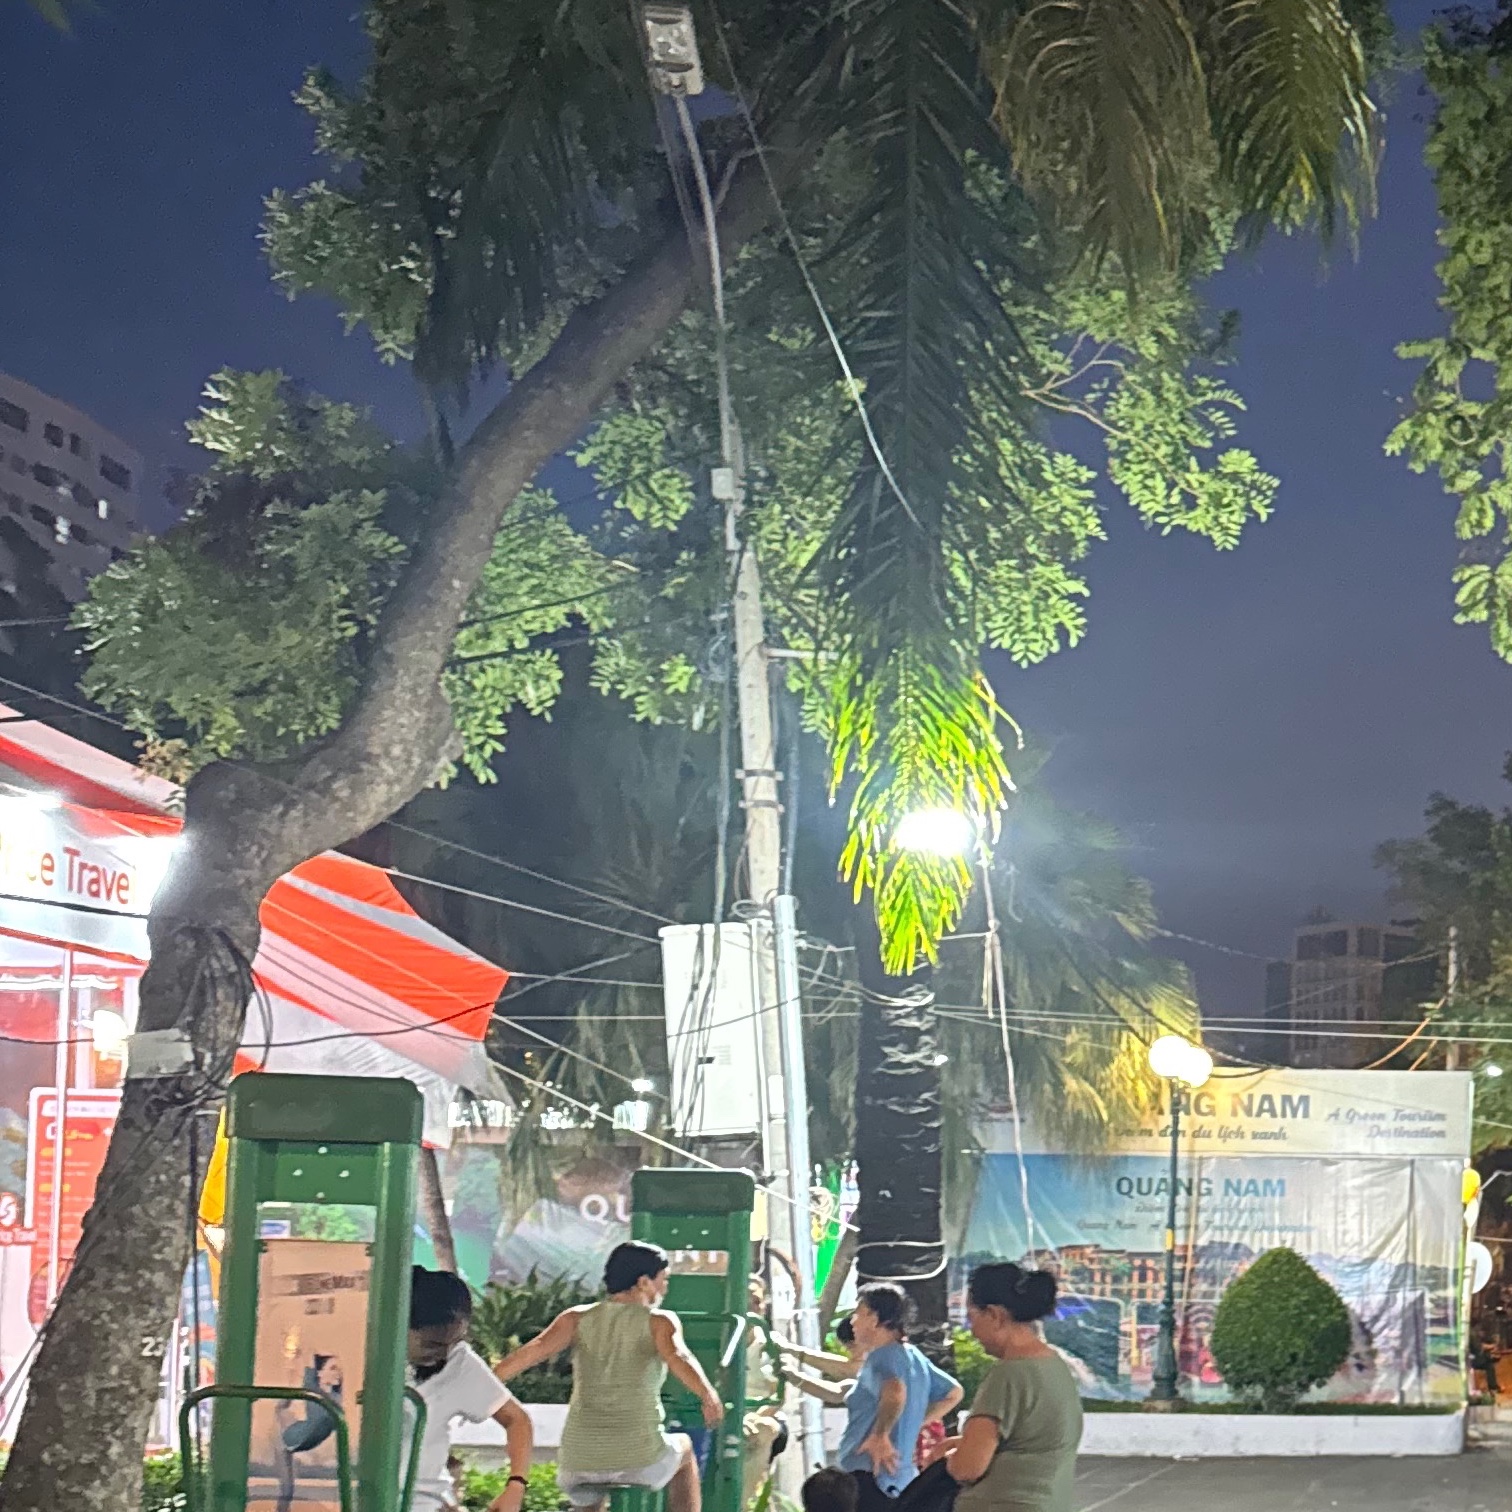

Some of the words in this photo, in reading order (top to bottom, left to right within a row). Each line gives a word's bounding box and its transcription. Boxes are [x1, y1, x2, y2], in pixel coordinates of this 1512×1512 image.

[63, 846, 136, 904] Trave
[1230, 1093, 1311, 1119] NAM
[1223, 1177, 1287, 1197] NAM
[580, 1193, 631, 1225] QU
